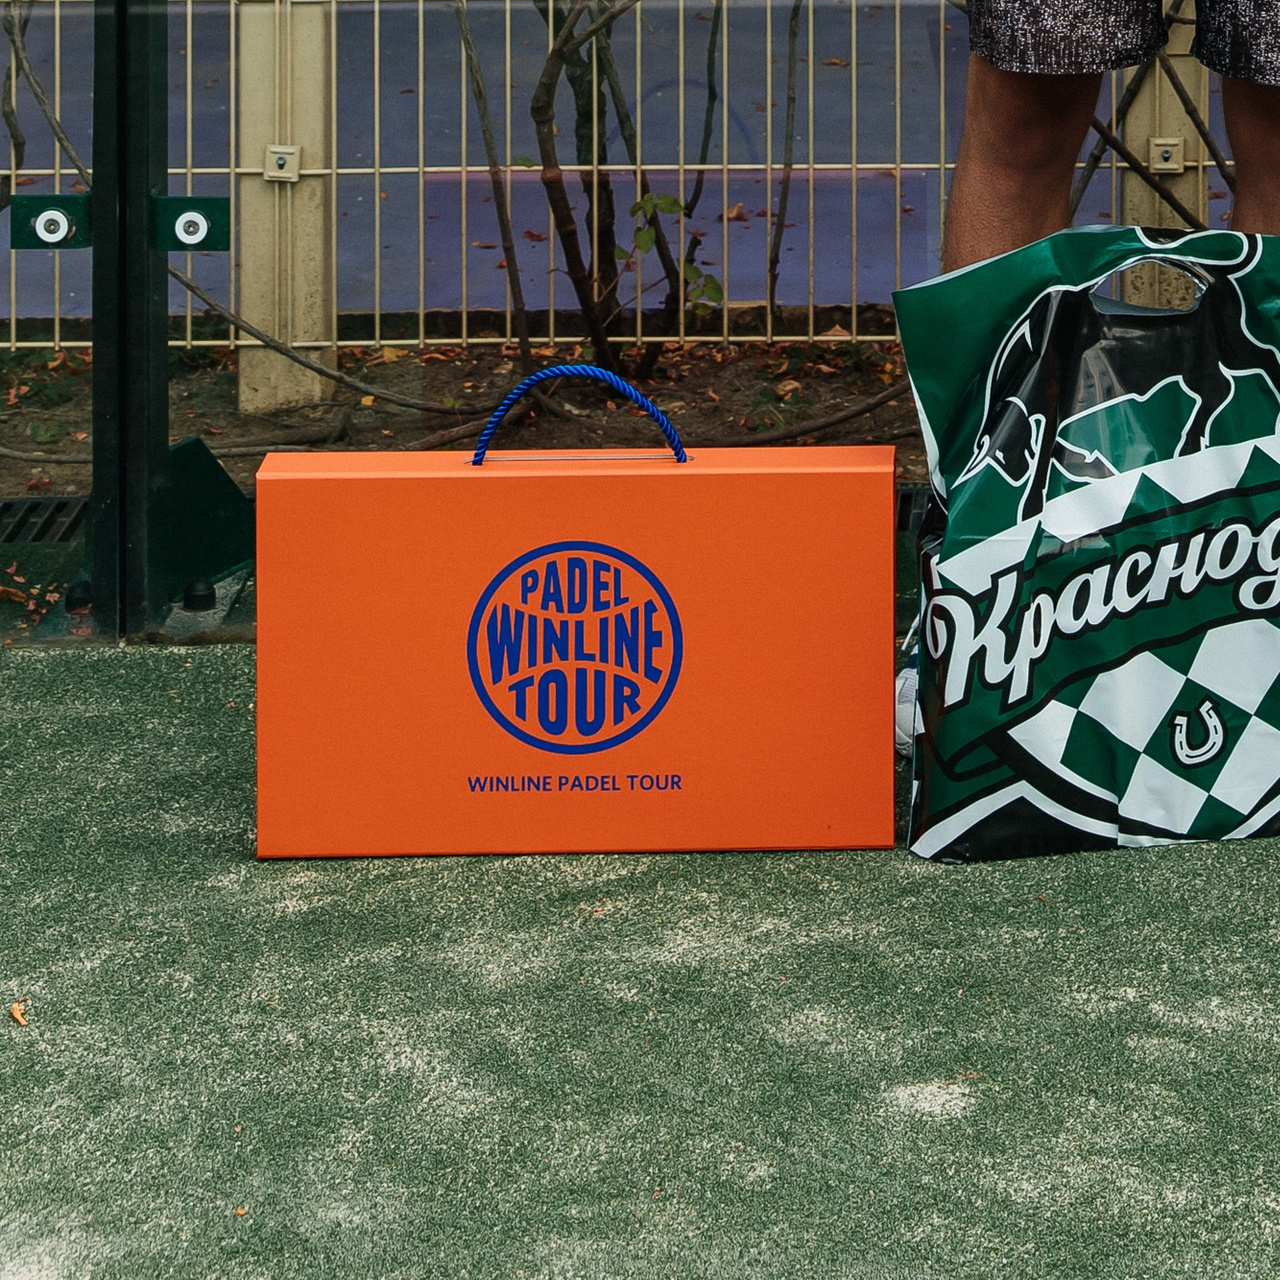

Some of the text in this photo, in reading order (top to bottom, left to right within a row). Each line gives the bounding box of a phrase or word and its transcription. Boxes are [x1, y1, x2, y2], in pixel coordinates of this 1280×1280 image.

[520, 556, 630, 614] PADEL
[486, 598, 664, 686] WINLINE
[508, 667, 642, 737] TOUR
[467, 774, 682, 792] WINLINE PADEL TOUR
